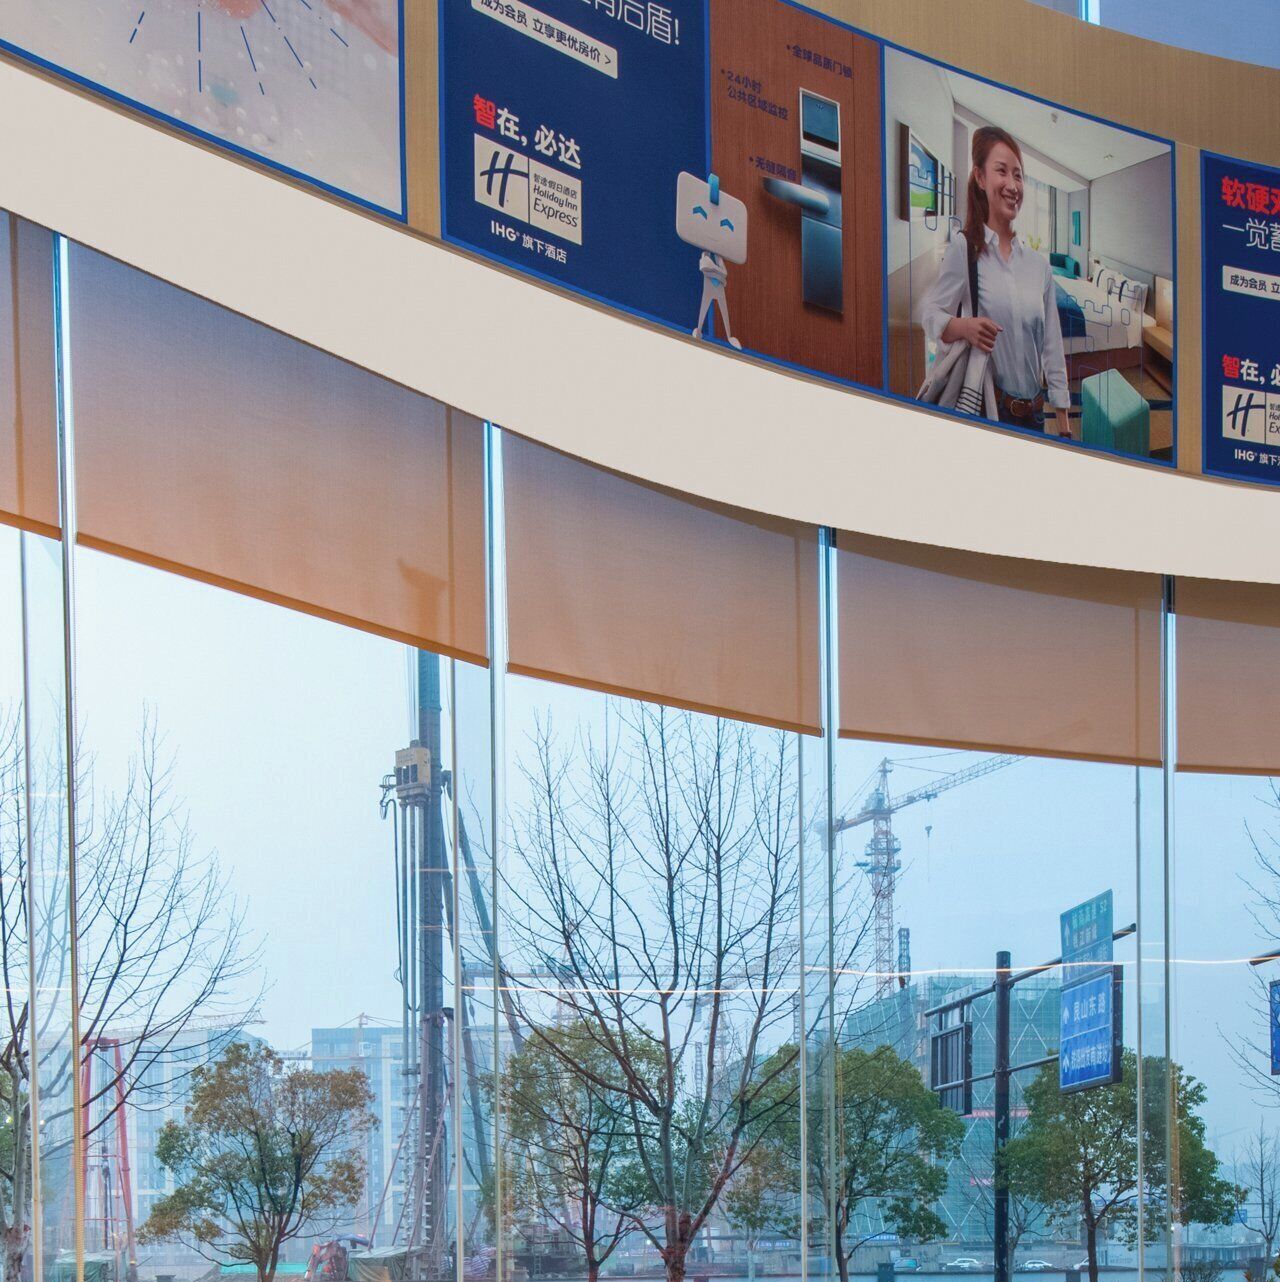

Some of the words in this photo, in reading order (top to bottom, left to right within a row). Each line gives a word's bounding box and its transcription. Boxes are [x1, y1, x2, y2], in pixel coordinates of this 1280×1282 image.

[531, 17, 601, 63] 立享更优房价
[727, 70, 762, 92] 24小时
[727, 85, 788, 120] 公共区域监控
[533, 184, 564, 207] Holiday
[564, 196, 578, 211] Inn
[533, 197, 579, 228] Express
[522, 233, 567, 264] 旗下酒店
[1230, 274, 1267, 292] 成为会员
